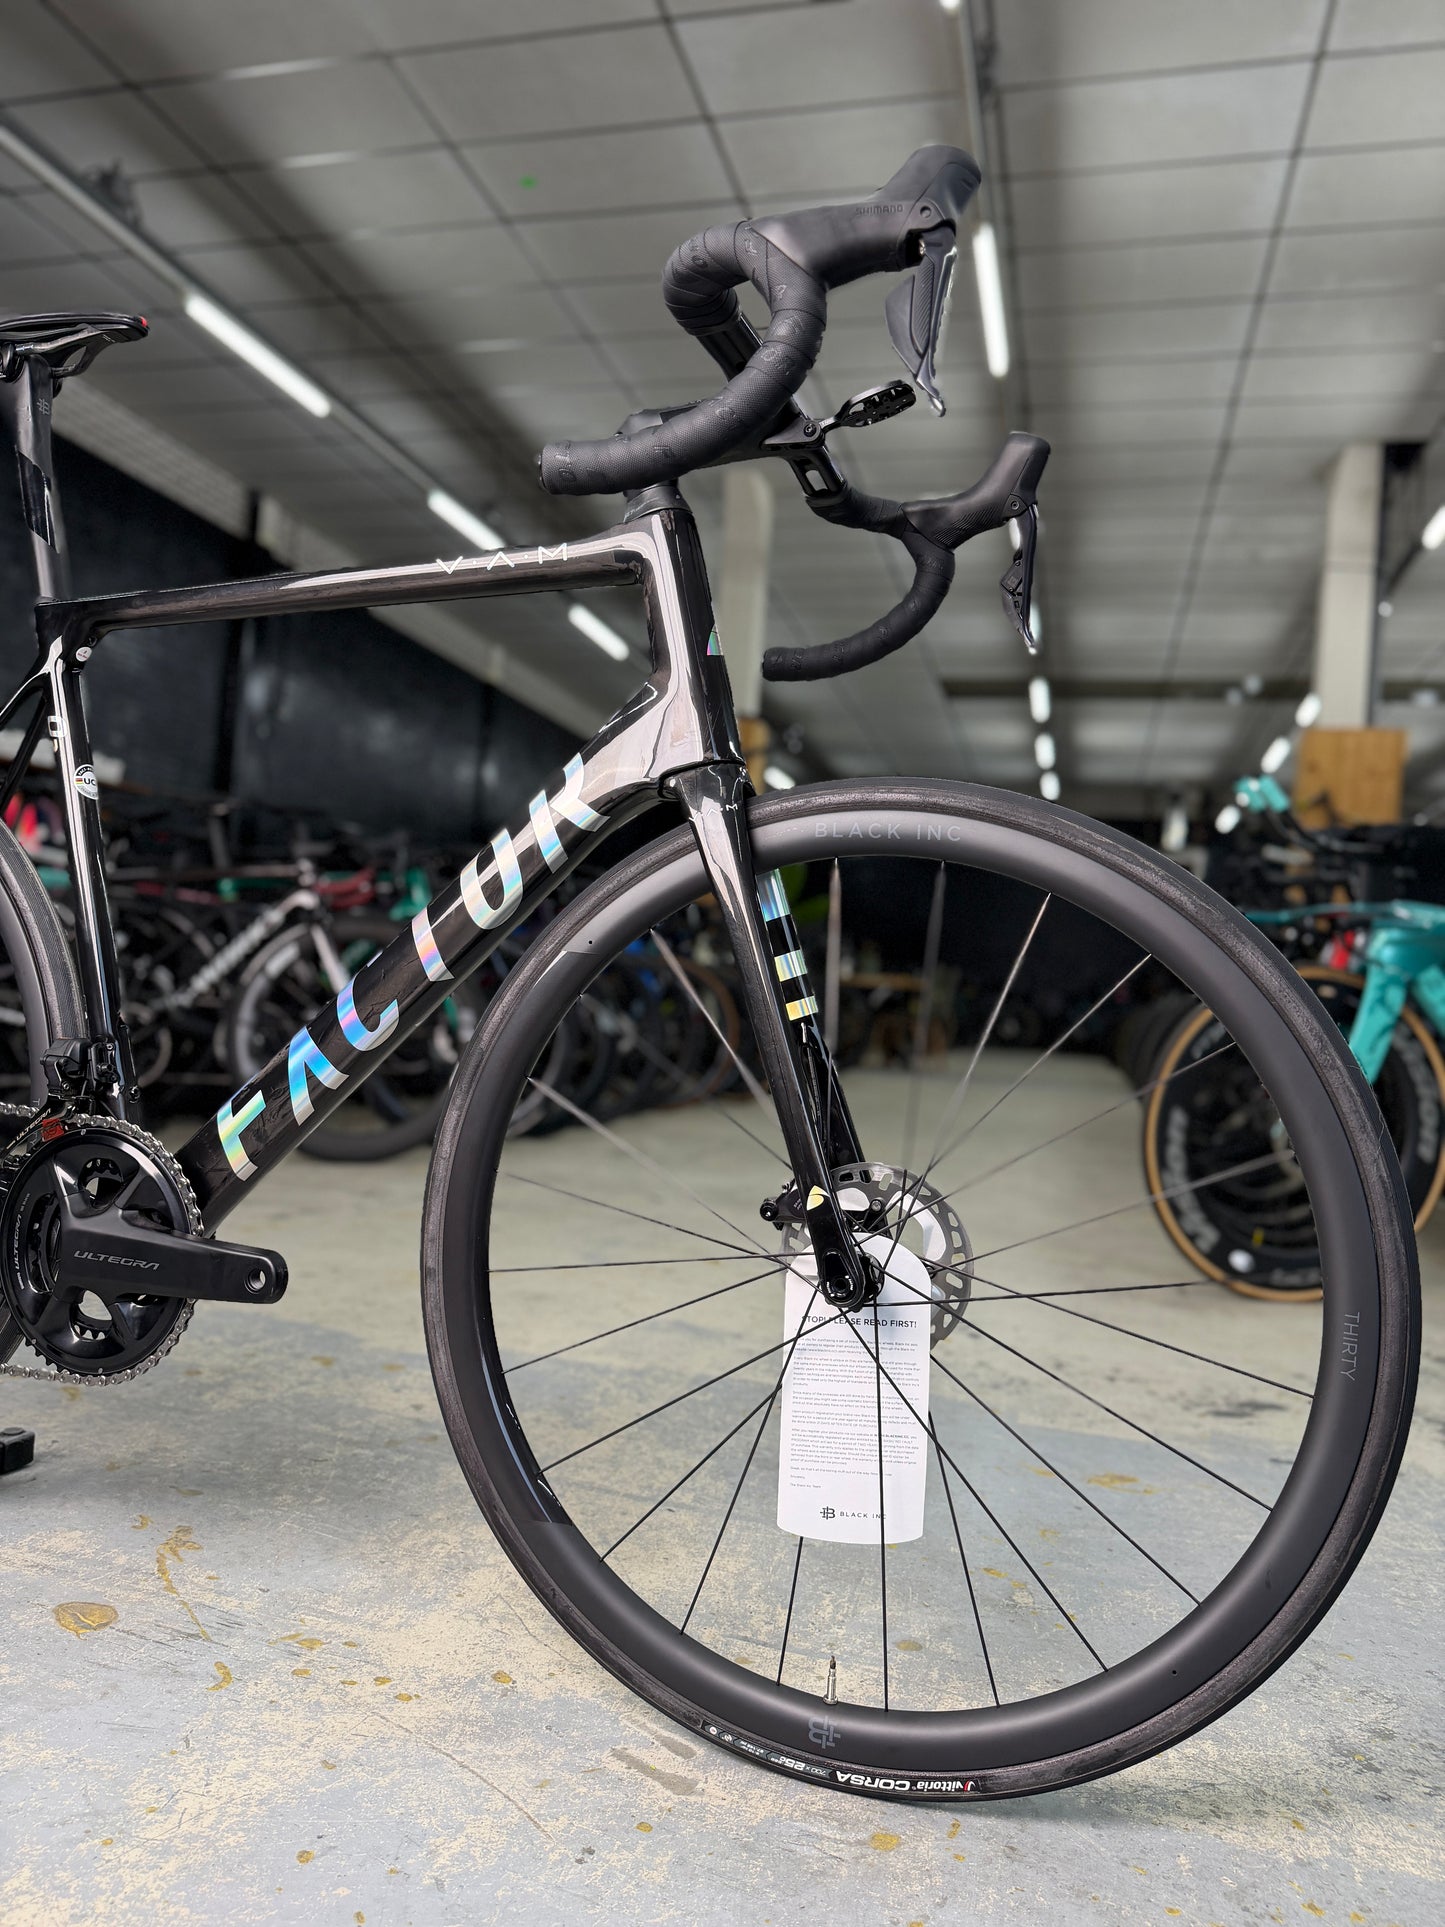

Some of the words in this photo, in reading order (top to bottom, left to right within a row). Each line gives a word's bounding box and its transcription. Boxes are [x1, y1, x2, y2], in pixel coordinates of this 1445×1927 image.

[815, 822, 901, 840] BLACK
[917, 824, 961, 842] INC
[73, 1250, 160, 1271] ULTEGRA
[890, 1319, 917, 1328] FIRST!
[1341, 1311, 1360, 1381] THIRTY
[836, 1770, 911, 1791] CORSA
